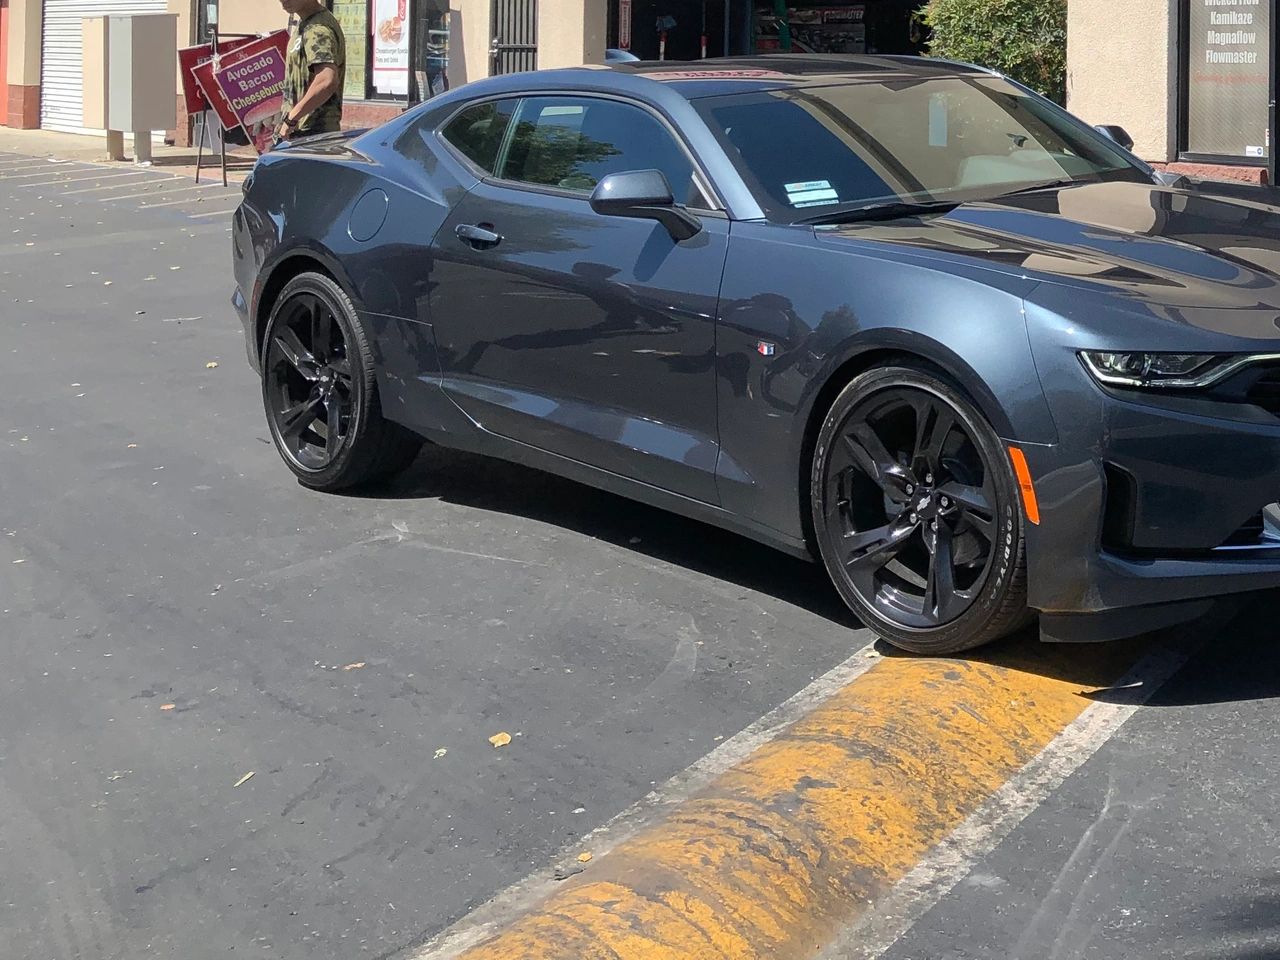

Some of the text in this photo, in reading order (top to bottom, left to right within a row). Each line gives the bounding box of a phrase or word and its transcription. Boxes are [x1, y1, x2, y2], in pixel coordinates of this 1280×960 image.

[1210, 11, 1253, 25] Kamikaze
[1207, 30, 1256, 46] Magnaflow
[1206, 50, 1257, 64] Flowmaster
[227, 56, 274, 82] Avocado
[238, 71, 275, 92] Bacon
